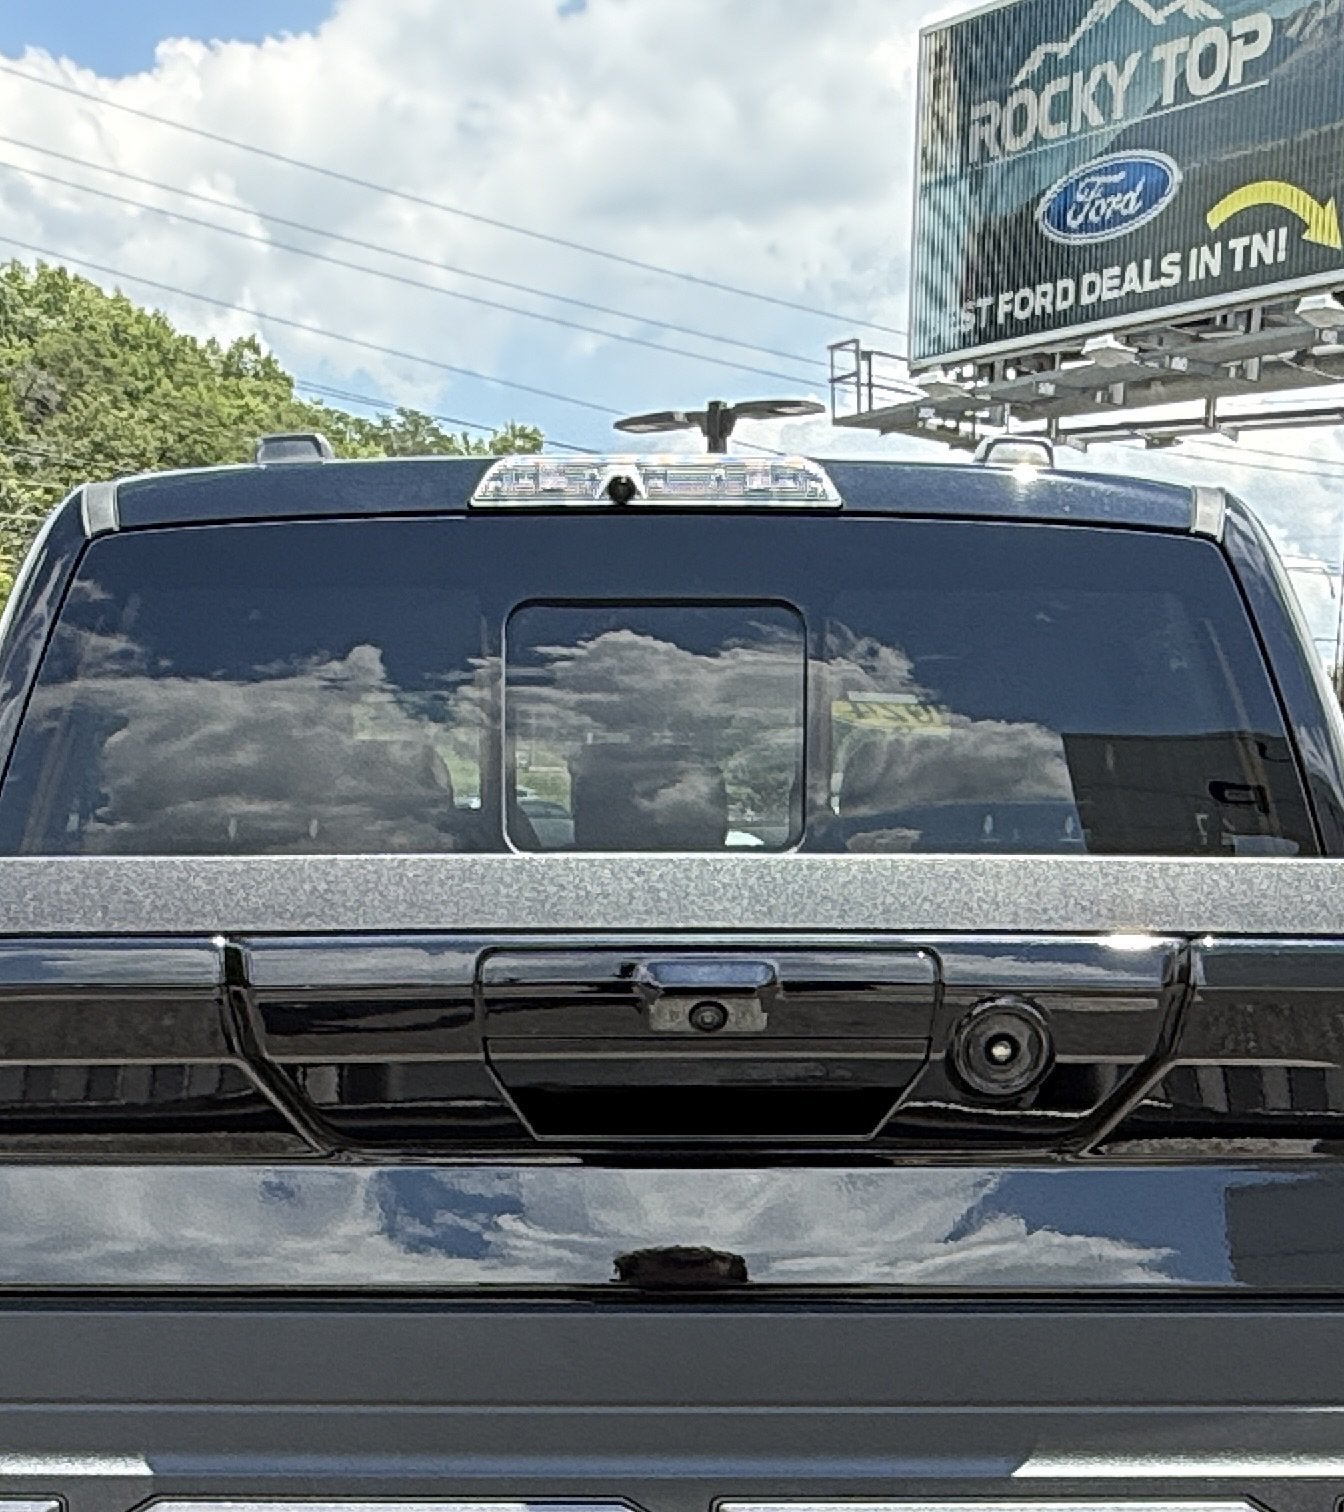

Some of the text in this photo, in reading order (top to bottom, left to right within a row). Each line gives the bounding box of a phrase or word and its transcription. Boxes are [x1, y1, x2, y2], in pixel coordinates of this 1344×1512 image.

[968, 12, 1273, 161] ROCKY TOP
[1066, 170, 1146, 229] Ford
[997, 278, 1076, 325] FORD
[1080, 252, 1182, 307] DEALS
[1188, 241, 1222, 282] IN
[1229, 226, 1289, 272] TN!
